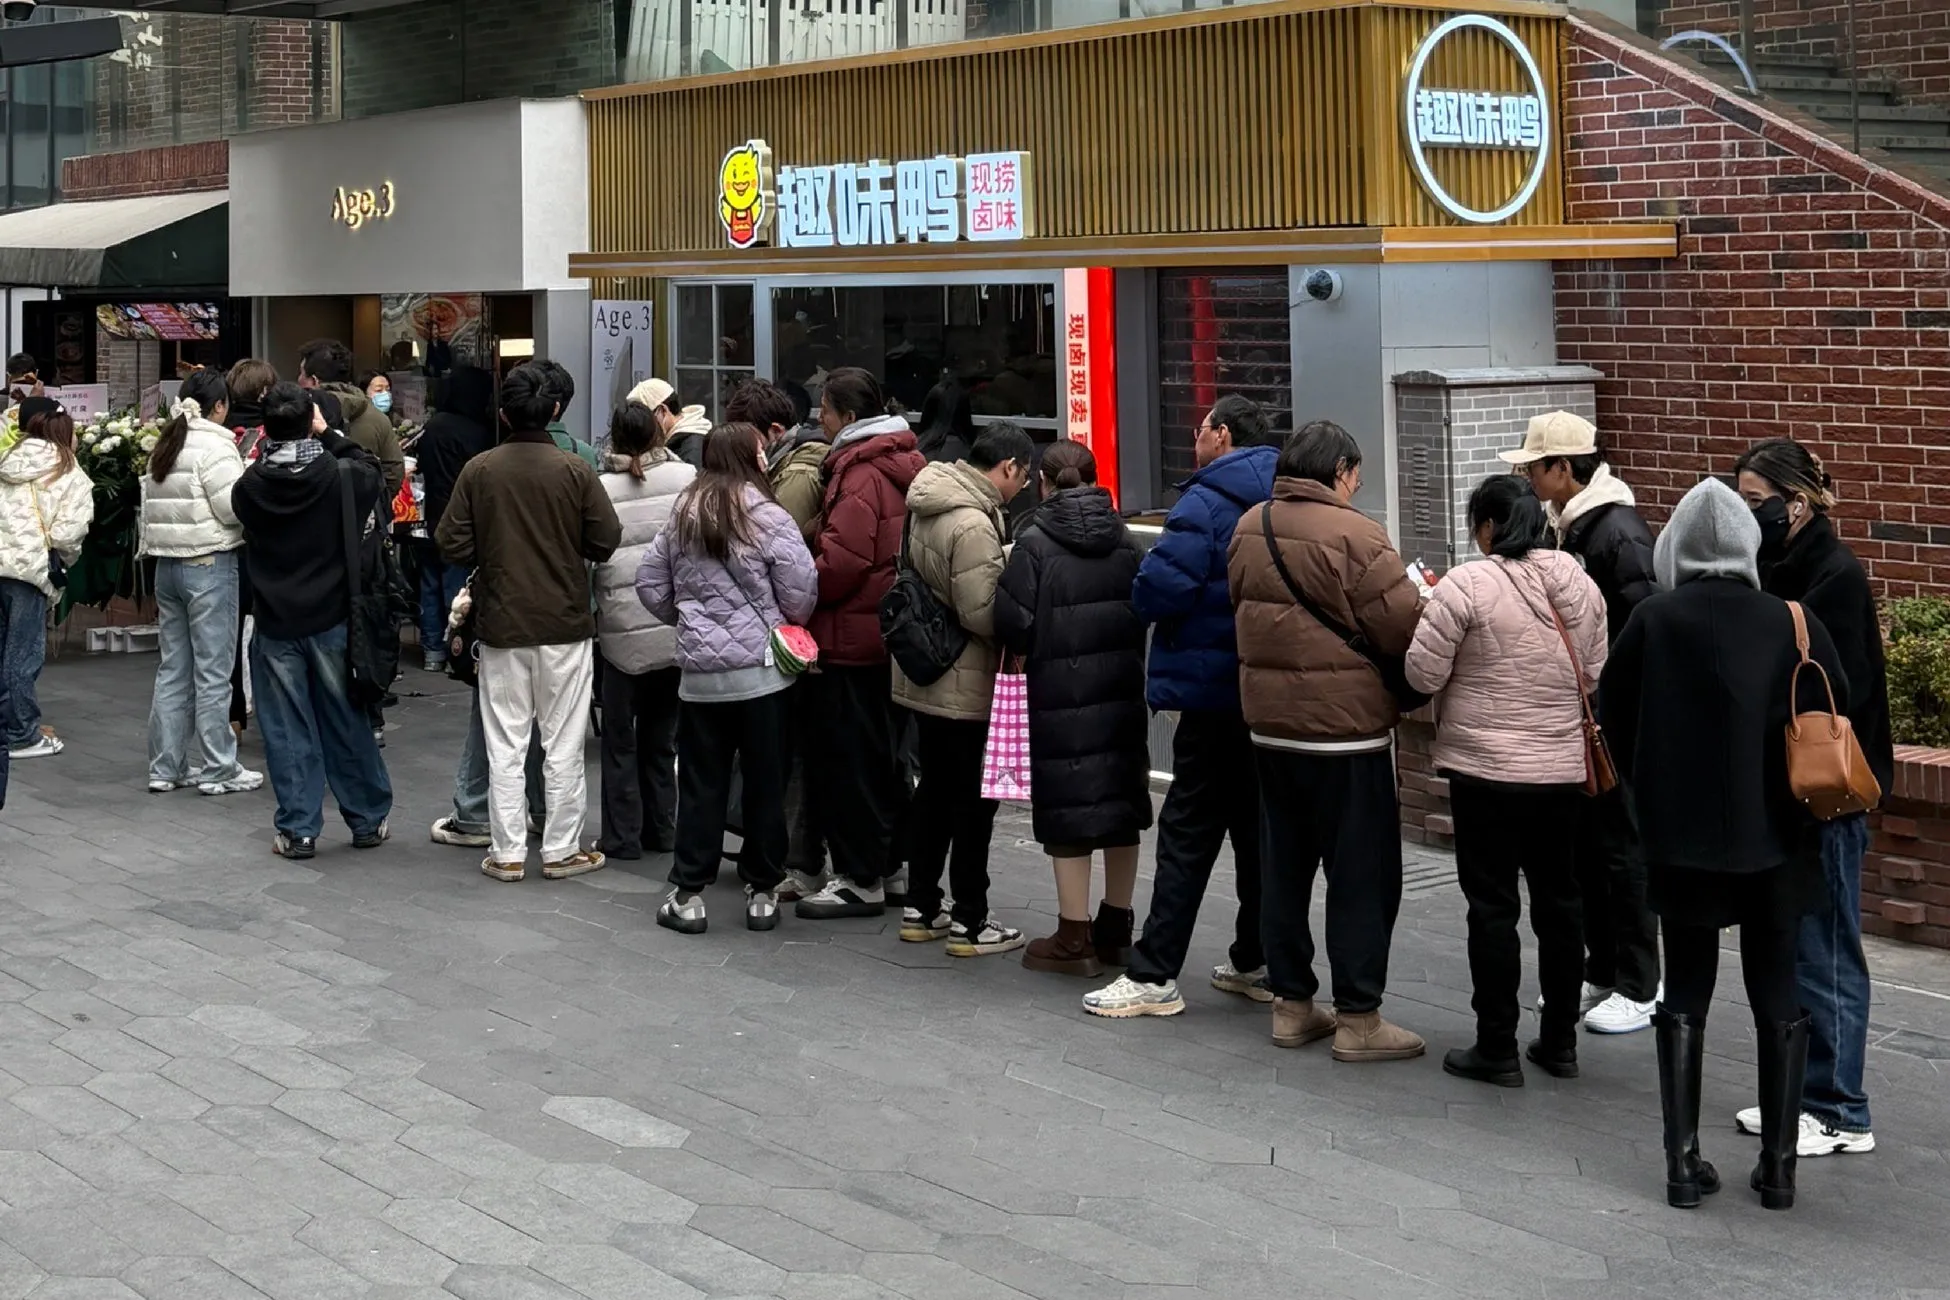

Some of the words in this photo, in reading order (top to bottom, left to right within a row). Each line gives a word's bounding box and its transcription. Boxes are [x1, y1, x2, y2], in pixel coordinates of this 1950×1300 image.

[1416, 89, 1540, 147] 趣味鸭
[971, 161, 1016, 194] 现捞
[331, 182, 394, 228] Age.3
[776, 155, 958, 247] 趣味鸭
[972, 199, 1017, 232] 卤味
[595, 305, 650, 337] Age.3
[1068, 314, 1088, 423] 现卤现卖
